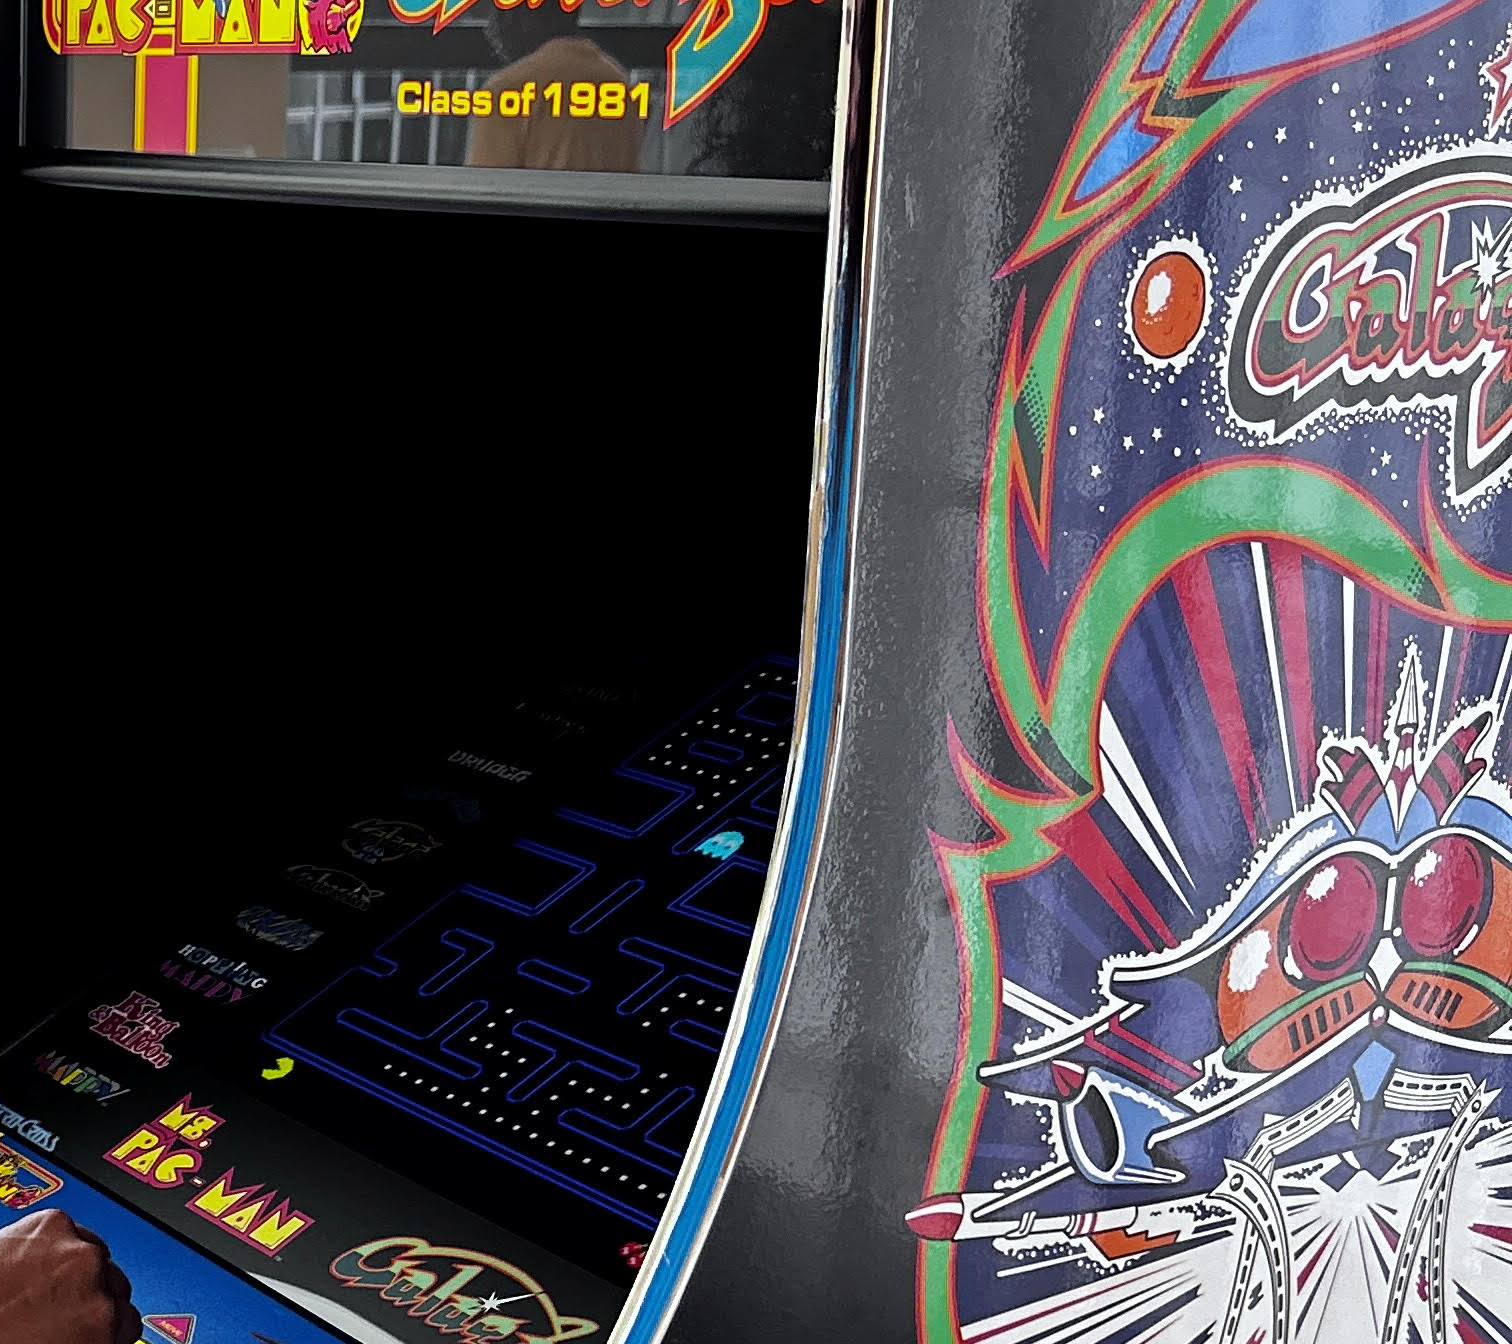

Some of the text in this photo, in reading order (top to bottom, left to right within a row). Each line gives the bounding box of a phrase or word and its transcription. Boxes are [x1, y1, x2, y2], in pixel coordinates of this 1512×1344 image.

[397, 81, 650, 119] Class of 1981
[102, 1123, 316, 1257] PAC-MAN
